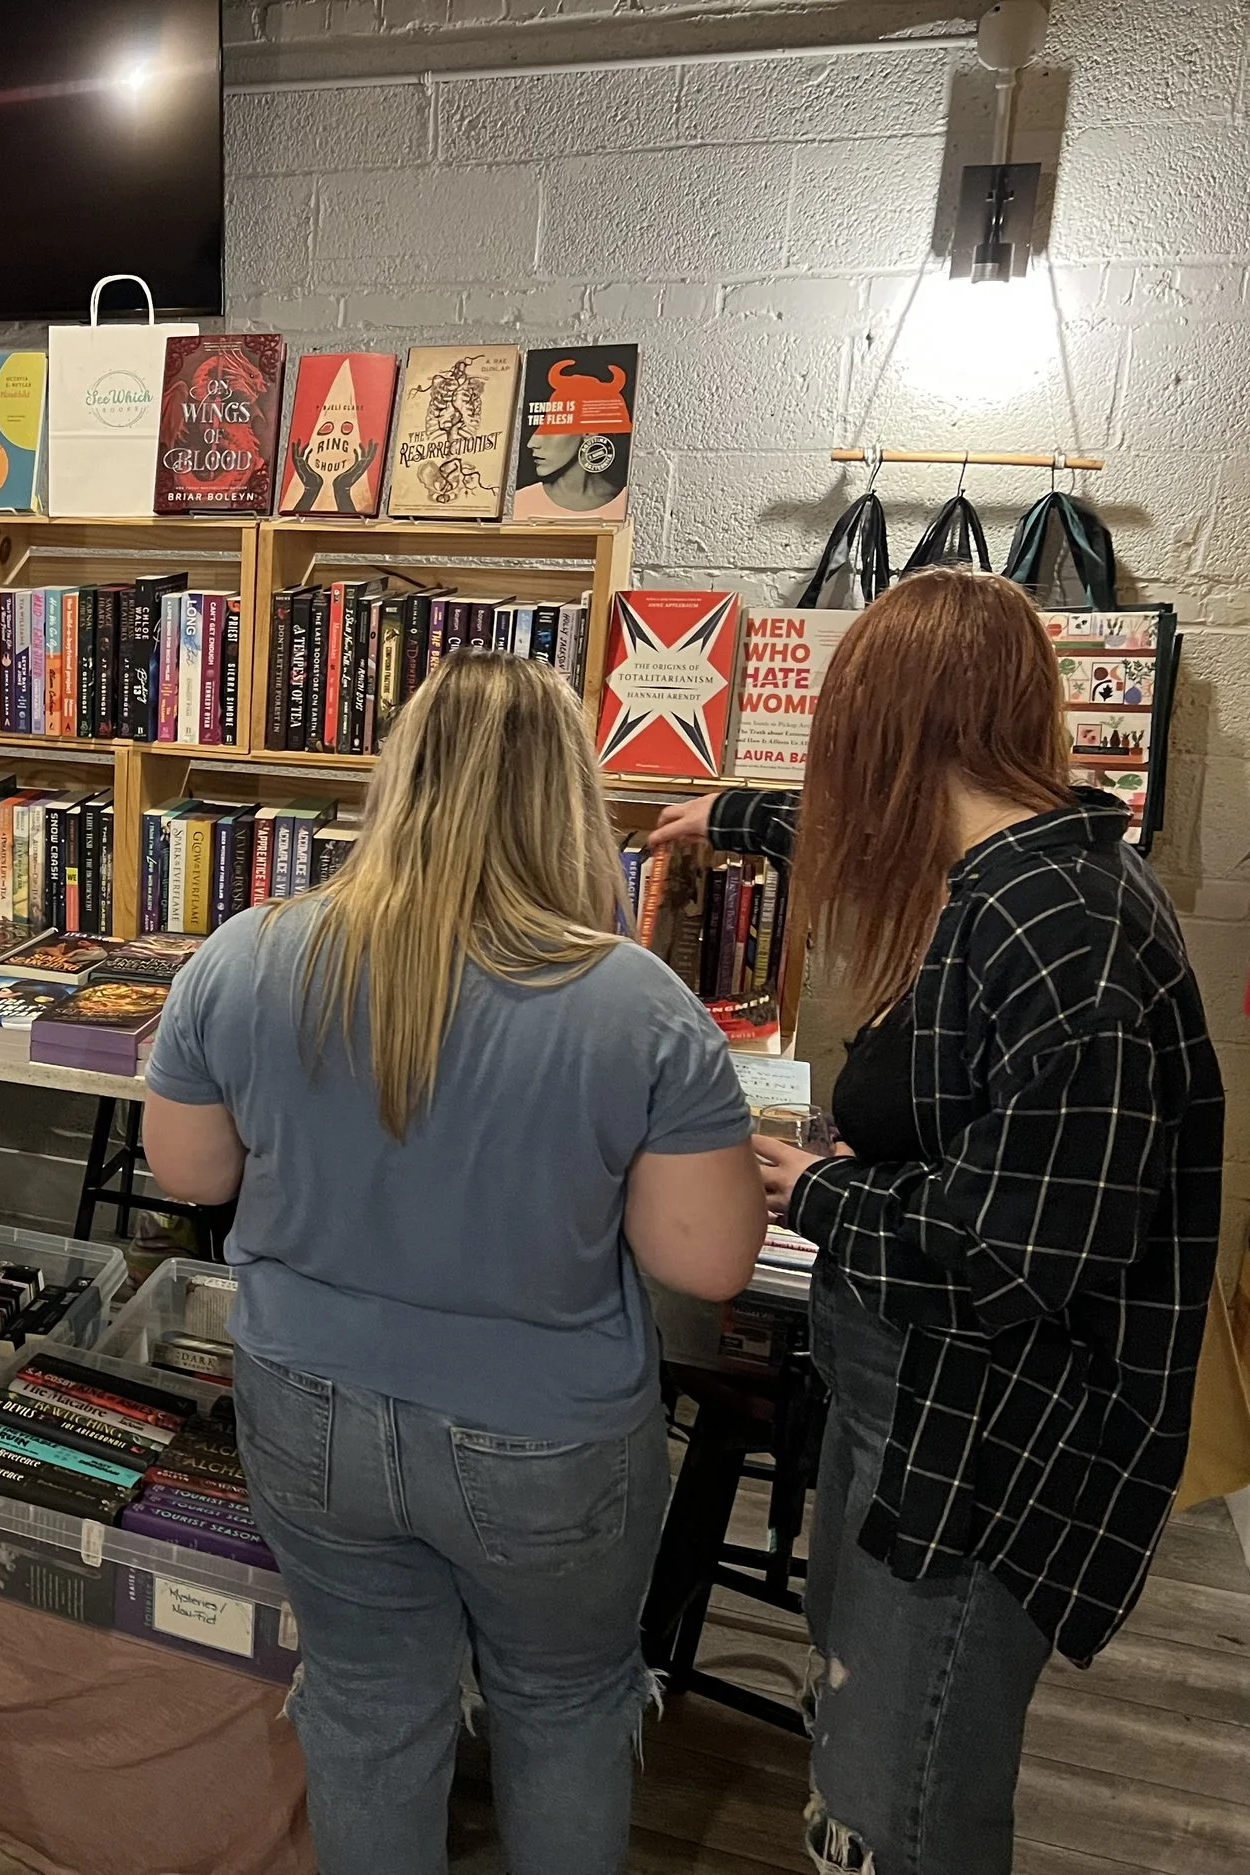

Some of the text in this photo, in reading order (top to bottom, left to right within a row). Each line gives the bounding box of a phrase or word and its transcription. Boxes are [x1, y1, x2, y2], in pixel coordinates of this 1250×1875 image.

[86, 389, 153, 406] See Which
[529, 401, 563, 413] TENDER
[567, 401, 576, 412] IS
[182, 402, 251, 423] WINGS
[528, 414, 574, 426] THE FLESH
[204, 429, 224, 444] OF
[317, 438, 349, 454] RING
[409, 431, 426, 444] THE
[400, 431, 503, 467] RESURRECTIONIST
[163, 448, 251, 473] BLOOD
[315, 459, 347, 472] SHOUT
[167, 493, 254, 501] BRIAR BOLEYN
[186, 600, 197, 635] LONG
[453, 609, 461, 630] Bayron
[746, 618, 805, 638] MEN
[432, 630, 441, 647] THE
[558, 613, 570, 670] HOLLY JACKSON
[743, 643, 811, 663] WHO
[225, 616, 238, 726] PRIEST SIERRA SIMONE
[407, 648, 418, 683] DARKER
[290, 637, 306, 727] TEMPEST OF TEA
[619, 673, 714, 684] TOTALITARIANISM
[741, 667, 810, 689] HATE
[133, 685, 141, 695] 13
[312, 694, 319, 705] ON
[627, 692, 664, 700] HANNAH
[274, 690, 282, 720] FOREST
[355, 693, 364, 711] BOYS
[274, 723, 280, 733] IN
[310, 707, 318, 730] EARTH
[734, 749, 784, 762] LAURA
[50, 813, 58, 843] SNOW
[255, 829, 269, 879] APPRENTICE
[277, 829, 290, 874] ACCOMPLICE
[296, 831, 308, 876] ACCOMPLICE
[172, 828, 183, 921] SPARK EVERFLAME
[190, 832, 204, 924] GLOW EVERFLAME
[233, 828, 246, 911] NEVER ROSES
[708, 995, 769, 1012] NGMEN
[181, 1351, 216, 1368] DARK
[2, 1400, 35, 1420] DEVILS
[22, 1383, 107, 1418] The Macabre
[35, 1400, 122, 1438] BEWITCHING
[75, 1427, 127, 1449] ABERCROMBIE
[174, 1489, 224, 1506] TOURIST
[153, 1508, 261, 1542] TOURIST SEASON
